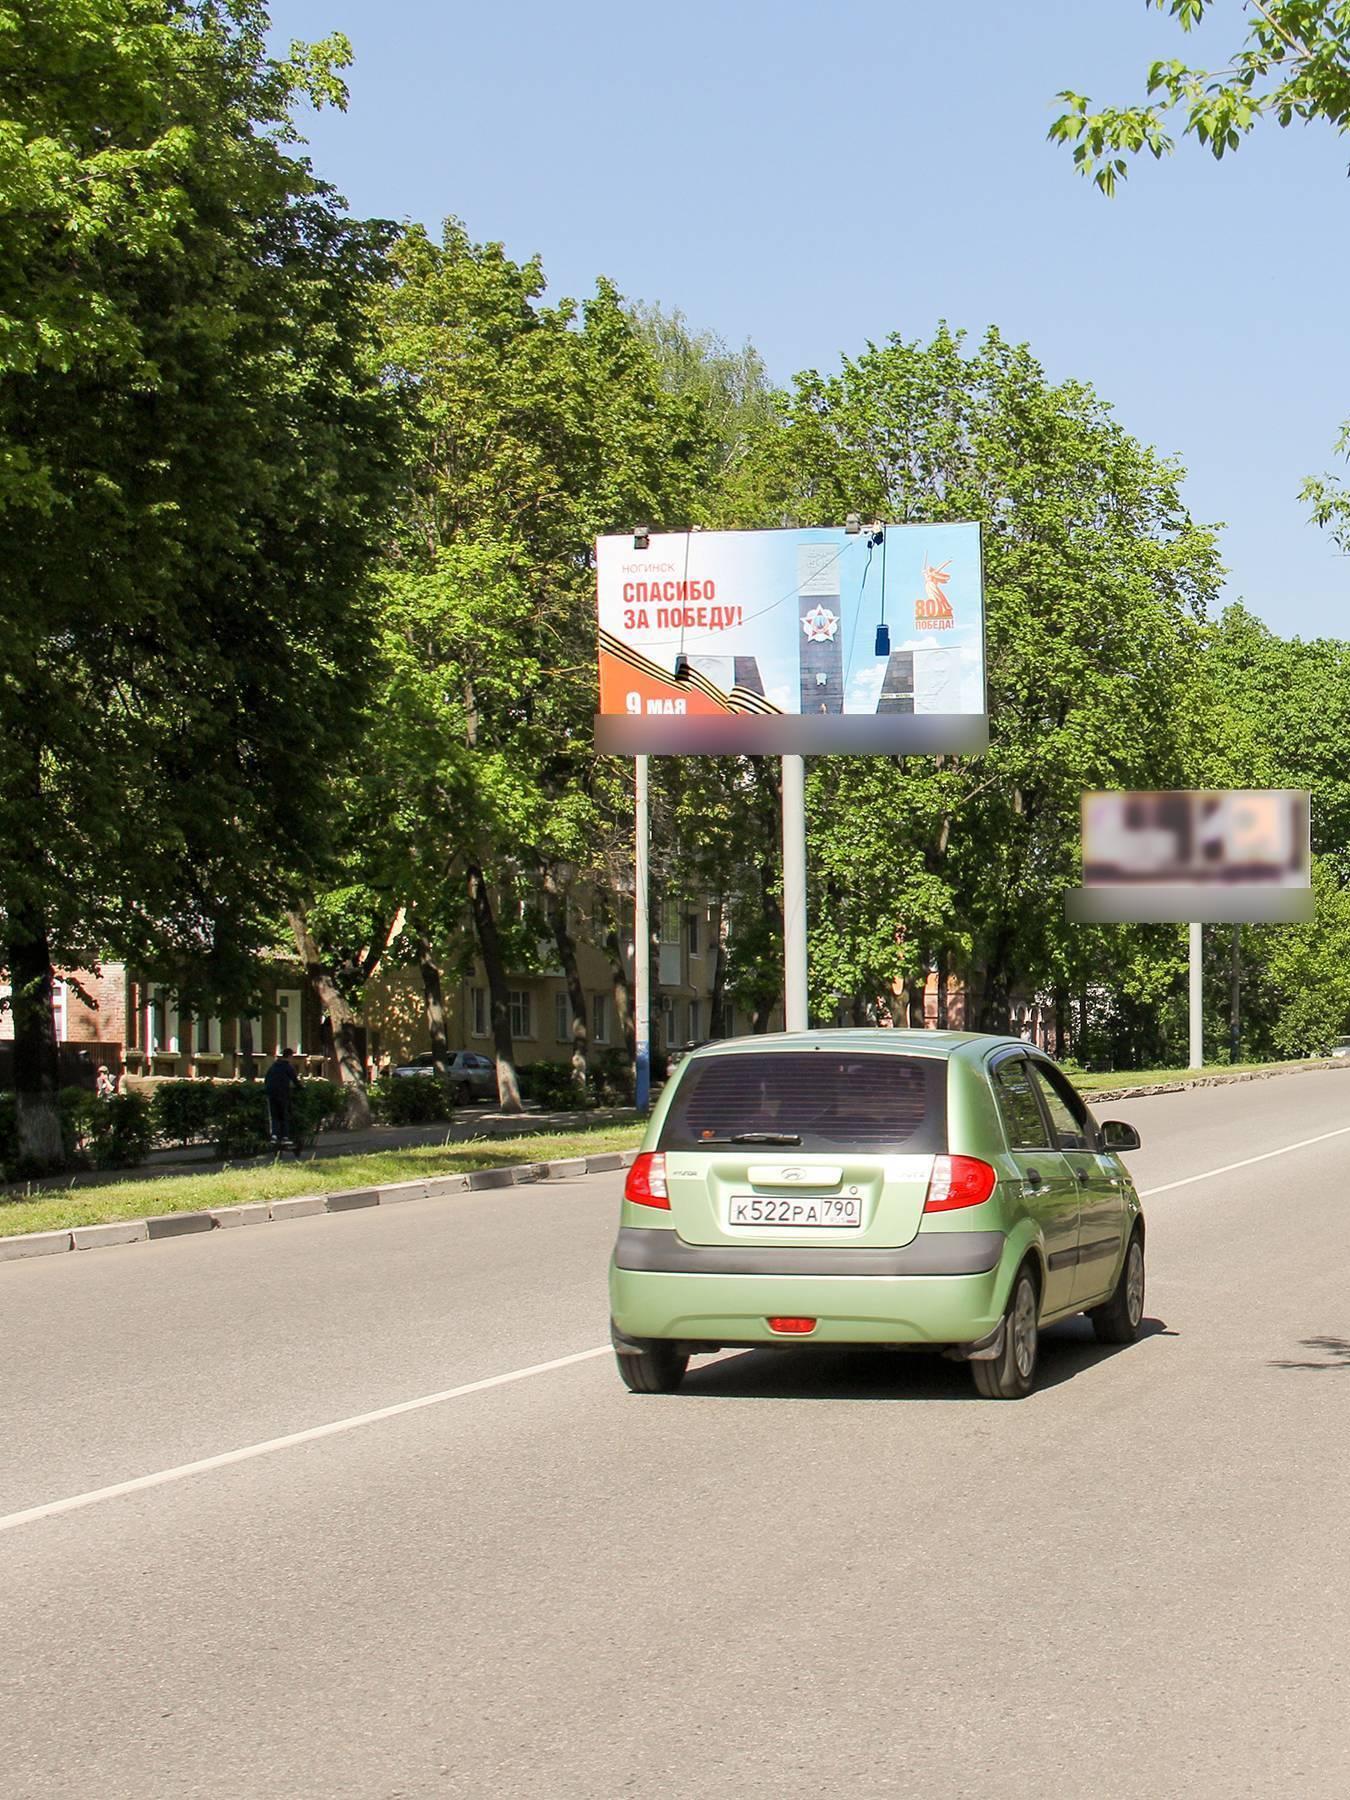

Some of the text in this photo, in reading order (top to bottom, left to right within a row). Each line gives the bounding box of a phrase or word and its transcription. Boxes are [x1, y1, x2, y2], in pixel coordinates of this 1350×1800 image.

[622, 563, 675, 573] НОГИНСК
[623, 580, 715, 602] СПАСИБО
[624, 606, 742, 630] ЗА ПОБЕДУ!
[915, 620, 954, 630] ПОБЕДА!
[626, 691, 686, 714] 9 МАЯ
